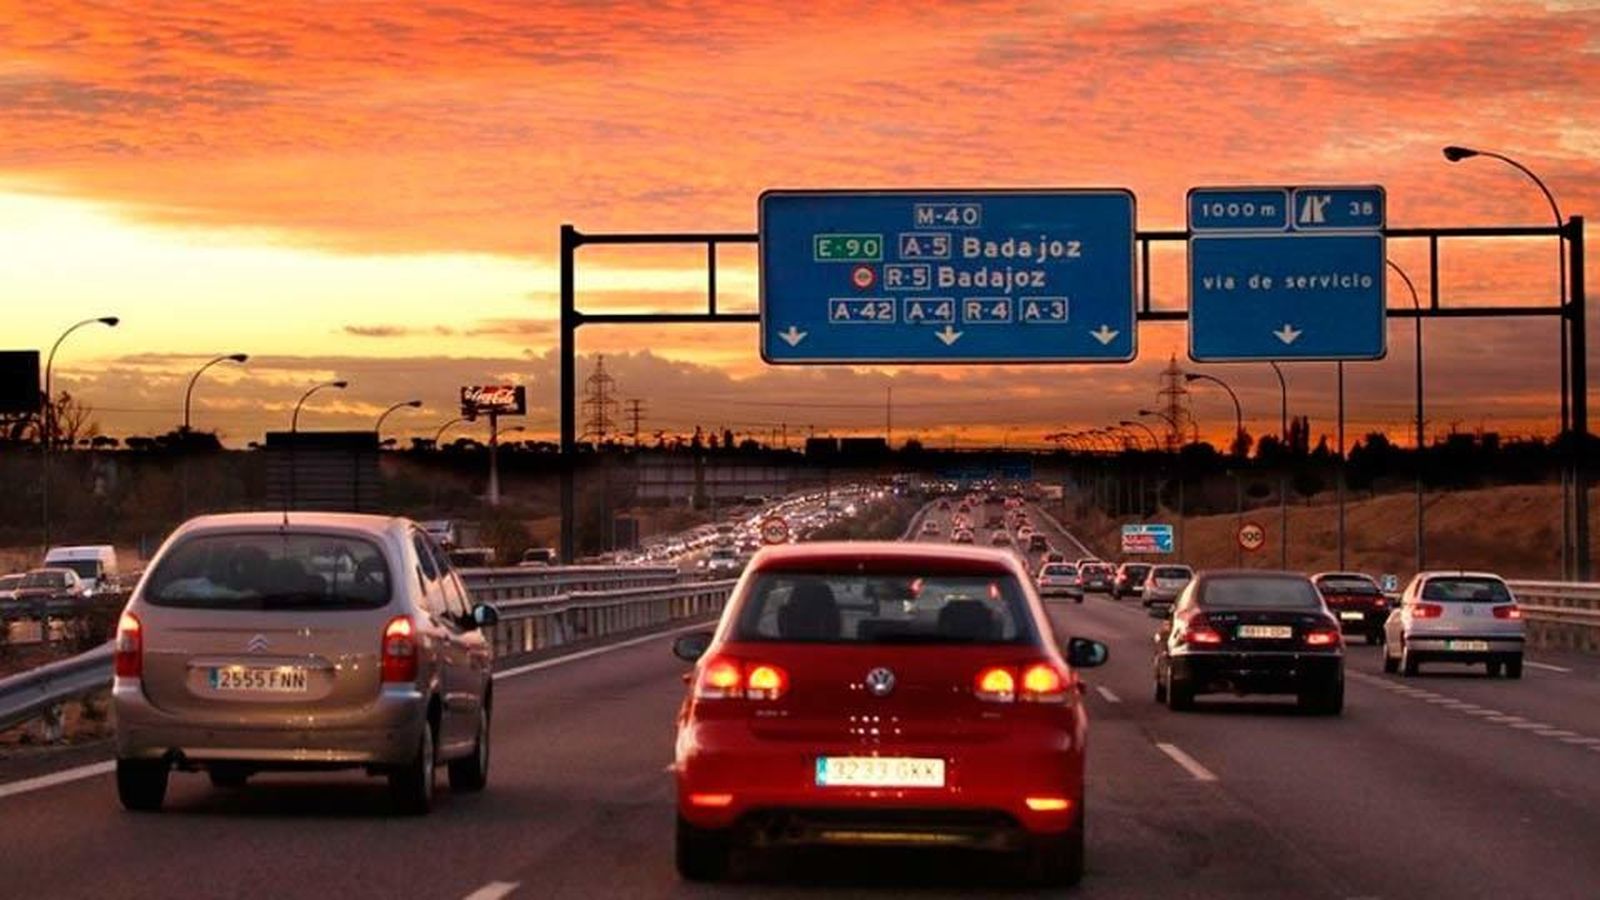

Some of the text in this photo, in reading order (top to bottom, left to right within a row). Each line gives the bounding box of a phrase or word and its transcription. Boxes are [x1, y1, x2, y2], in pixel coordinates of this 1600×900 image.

[917, 207, 978, 225] M-40
[1202, 203, 1275, 217] 1000 m
[1350, 201, 1374, 216] 38
[904, 235, 1081, 264] A-5 Badajoz
[888, 266, 1046, 294] R-5 Badajoz
[1249, 273, 1273, 290] de
[1285, 272, 1374, 289] servicio
[834, 302, 1064, 320] A-42 A-4 R-4 A-3
[221, 670, 305, 688] 2555 FNN
